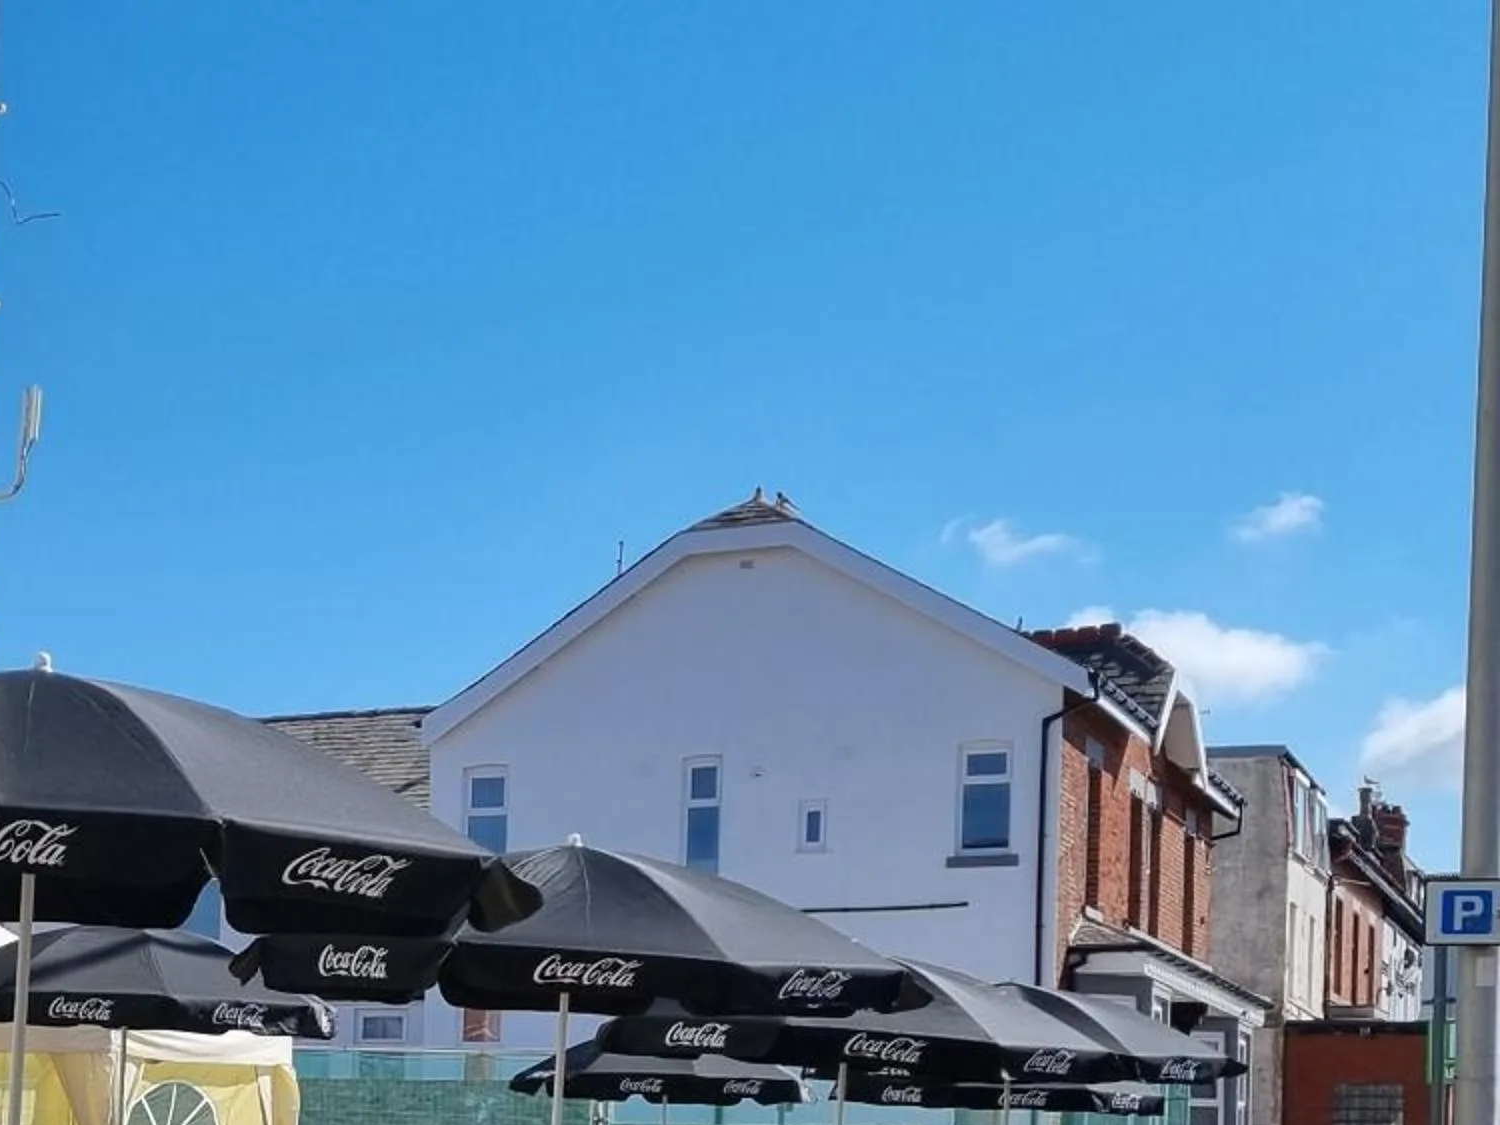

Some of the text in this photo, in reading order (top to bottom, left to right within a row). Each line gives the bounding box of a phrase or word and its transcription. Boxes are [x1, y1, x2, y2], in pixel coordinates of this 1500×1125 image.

[281, 847, 412, 898] Coca-Cola
[1453, 895, 1484, 930] P
[318, 943, 389, 979] Coca-Cola
[533, 953, 645, 987] Coca-Cola
[48, 996, 116, 1023] Coca-Cola
[665, 1021, 732, 1048] Coca-Cola
[844, 1032, 929, 1063] Coca-Cola
[997, 1087, 1048, 1108] Cca-Cola
